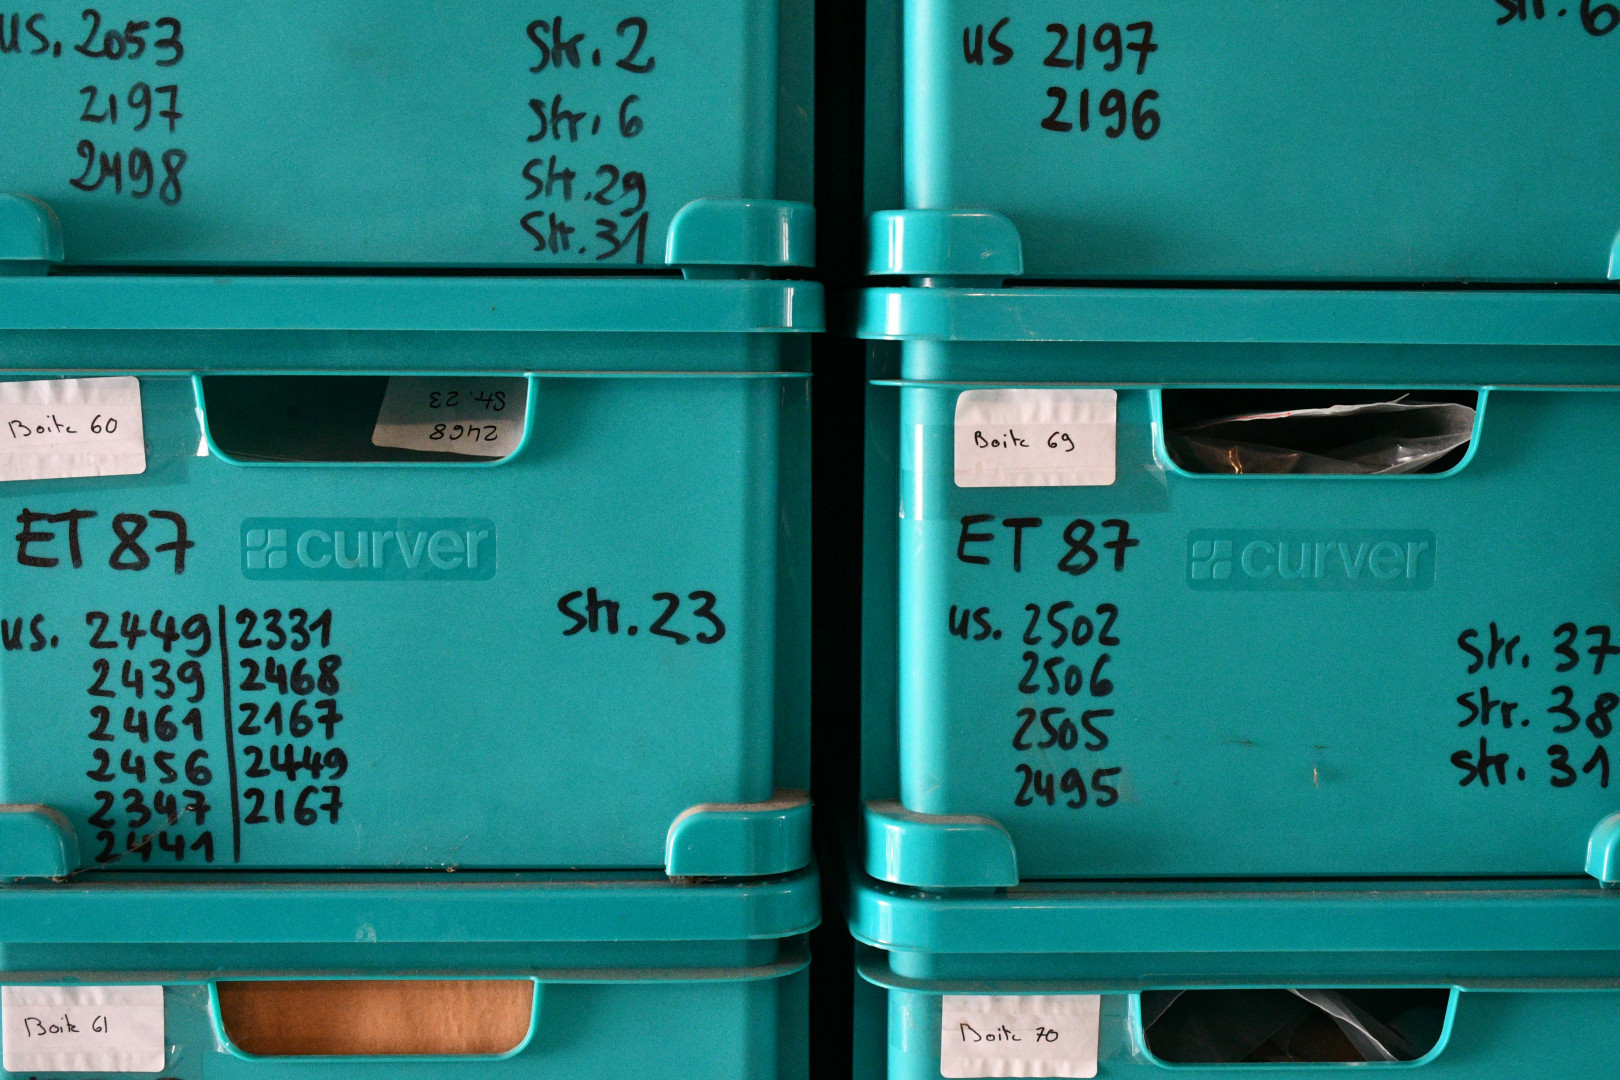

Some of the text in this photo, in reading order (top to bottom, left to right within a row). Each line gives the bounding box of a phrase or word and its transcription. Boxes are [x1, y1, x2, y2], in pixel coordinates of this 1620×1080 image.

[74, 9, 183, 66] 2053
[616, 17, 655, 73] 2
[1043, 21, 1158, 74] 2197
[80, 82, 182, 131] 2197
[619, 95, 643, 137] 6
[1041, 87, 1160, 140] 2196
[70, 140, 185, 205] 2498
[430, 391, 459, 408] 23
[91, 415, 117, 433] 60
[429, 423, 497, 441] 2468
[1048, 432, 1074, 452] 69
[16, 508, 194, 574] ET 87
[297, 528, 489, 569] curver
[957, 513, 1139, 576] ET 87
[1241, 540, 1429, 580] curver
[86, 610, 211, 657] 2449
[236, 608, 332, 651] 2331
[649, 591, 725, 645] 23
[1023, 601, 1120, 648] 2502
[1554, 622, 1620, 675] 37
[87, 658, 205, 703] 2439
[240, 655, 341, 696] 2468
[1018, 651, 1113, 697] 2506
[88, 705, 203, 743] 2461
[238, 699, 343, 740] 2167
[1013, 707, 1114, 751] 2505
[1547, 686, 1620, 738] 38
[86, 748, 212, 786] 2456
[244, 744, 348, 781] 2449
[1547, 744, 1609, 788] 31
[244, 785, 343, 826] 2167
[1015, 764, 1121, 809] 2495
[88, 789, 210, 829] 2347
[95, 830, 213, 863] 2441
[92, 1016, 107, 1033] 61
[1036, 1026, 1059, 1043] 70
